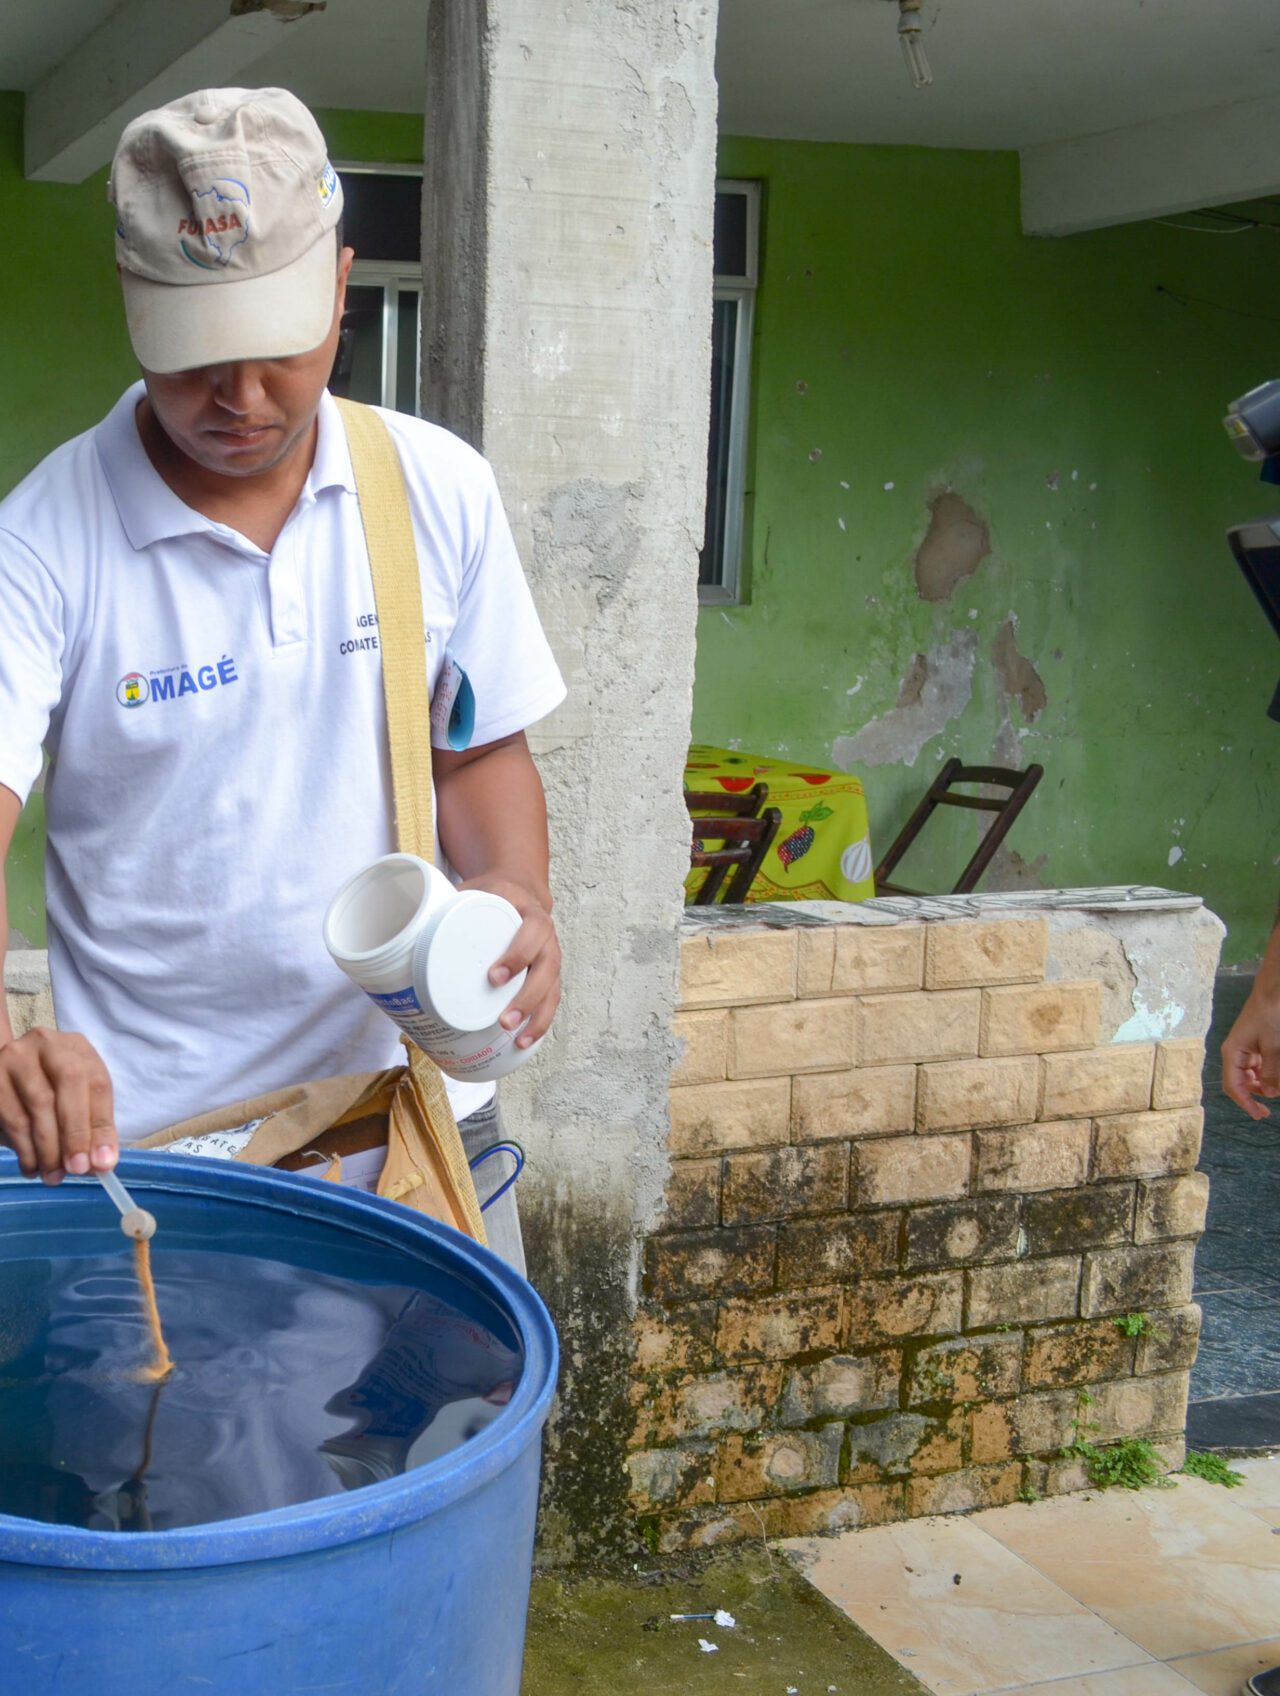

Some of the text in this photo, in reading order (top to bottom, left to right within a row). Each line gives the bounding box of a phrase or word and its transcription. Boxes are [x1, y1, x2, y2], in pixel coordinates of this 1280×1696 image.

[177, 212, 242, 236] FUASA
[150, 654, 239, 702] MAGÉ
[459, 1047, 493, 1065] CUIDADO
